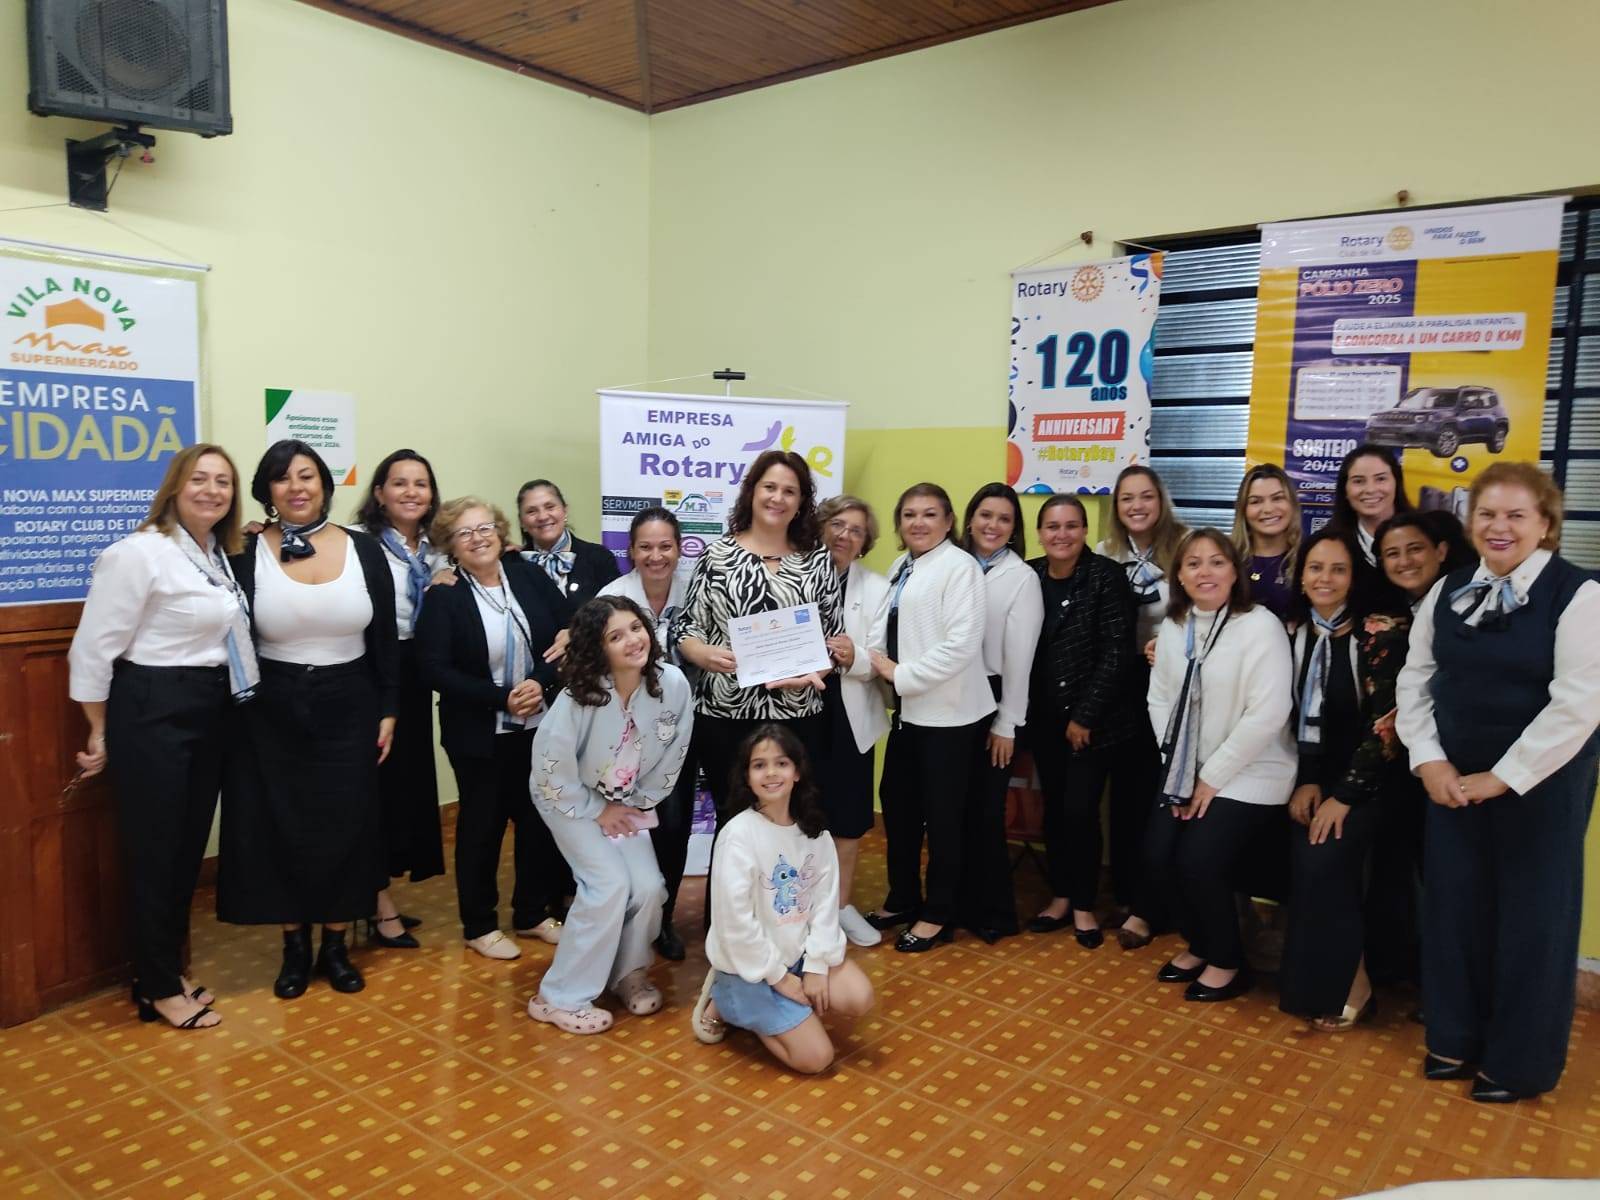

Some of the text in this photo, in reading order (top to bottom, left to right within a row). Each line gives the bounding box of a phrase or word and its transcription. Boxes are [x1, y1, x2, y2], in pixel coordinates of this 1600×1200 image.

[1340, 235, 1384, 248] Rotary
[1302, 268, 1369, 280] CAMPANHA
[1018, 280, 1068, 298] Rotary
[1353, 277, 1403, 294] ZERO
[6, 277, 136, 331] VILA NOVA
[1367, 294, 1401, 304] 2025
[1344, 332, 1405, 347] CONCORRA
[1407, 332, 1415, 344] A
[1420, 332, 1438, 344] UM
[1441, 331, 1481, 343] CARRO
[10, 352, 139, 371] SUPERMERCADO
[1035, 328, 1130, 389] 120
[0, 380, 150, 413] EMPRESA
[1091, 385, 1127, 401] anos
[647, 410, 734, 427] EMPRESA
[1038, 417, 1120, 436] ANNIVERSARY
[622, 431, 711, 449] AMIGA DO
[1293, 439, 1357, 457] SORTEIO
[1038, 445, 1116, 463] #RotaryDay
[640, 453, 746, 486] Rotary
[4, 489, 49, 502] NOVA
[53, 490, 86, 501] MAX
[47, 506, 76, 514] com
[80, 506, 94, 514] os
[96, 503, 151, 514] rotariano
[603, 499, 650, 511] SERVMED
[15, 521, 67, 533] ROTARY
[71, 519, 105, 532] CLUB
[109, 519, 124, 531] DE
[62, 534, 111, 545] projetos
[64, 548, 87, 557] nas
[0, 562, 74, 575] umanitárias
[76, 563, 85, 572] e
